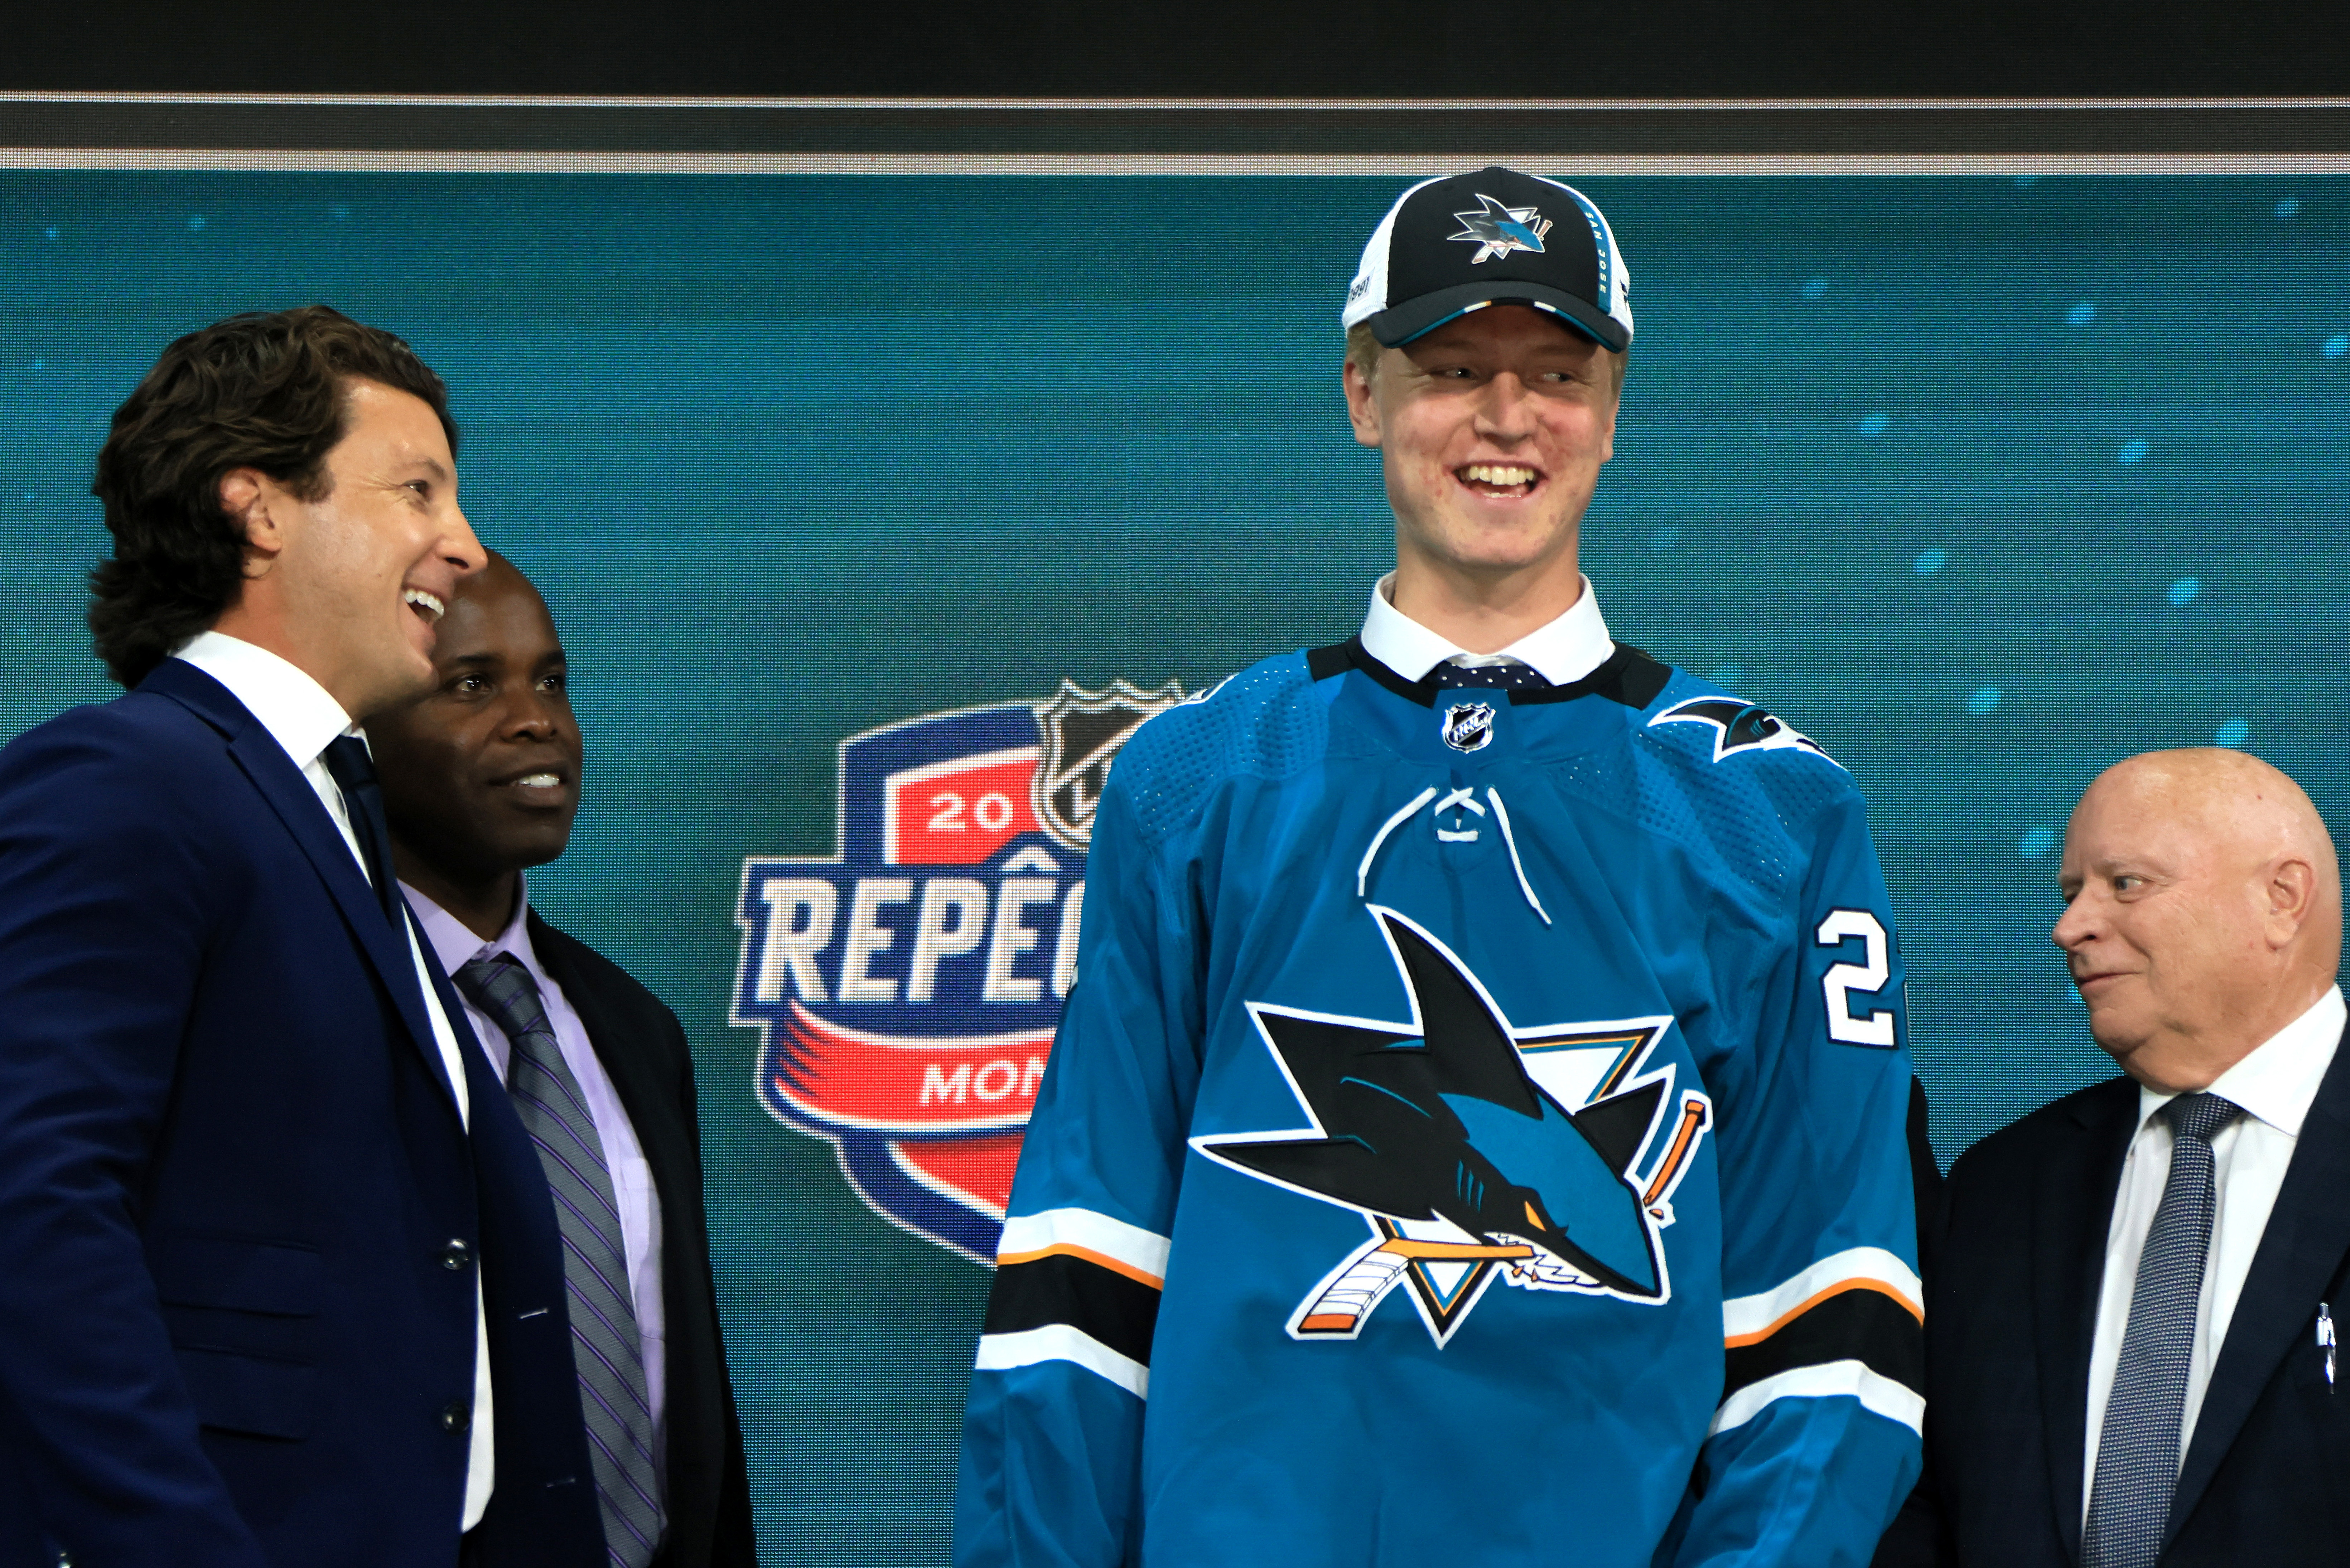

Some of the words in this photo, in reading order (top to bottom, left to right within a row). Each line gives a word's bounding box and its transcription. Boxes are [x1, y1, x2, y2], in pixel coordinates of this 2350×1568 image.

[1585, 212, 1603, 240] SAN
[1598, 249, 1607, 294] JOSE
[927, 793, 1014, 832] 20
[1814, 906, 1911, 1050] 2
